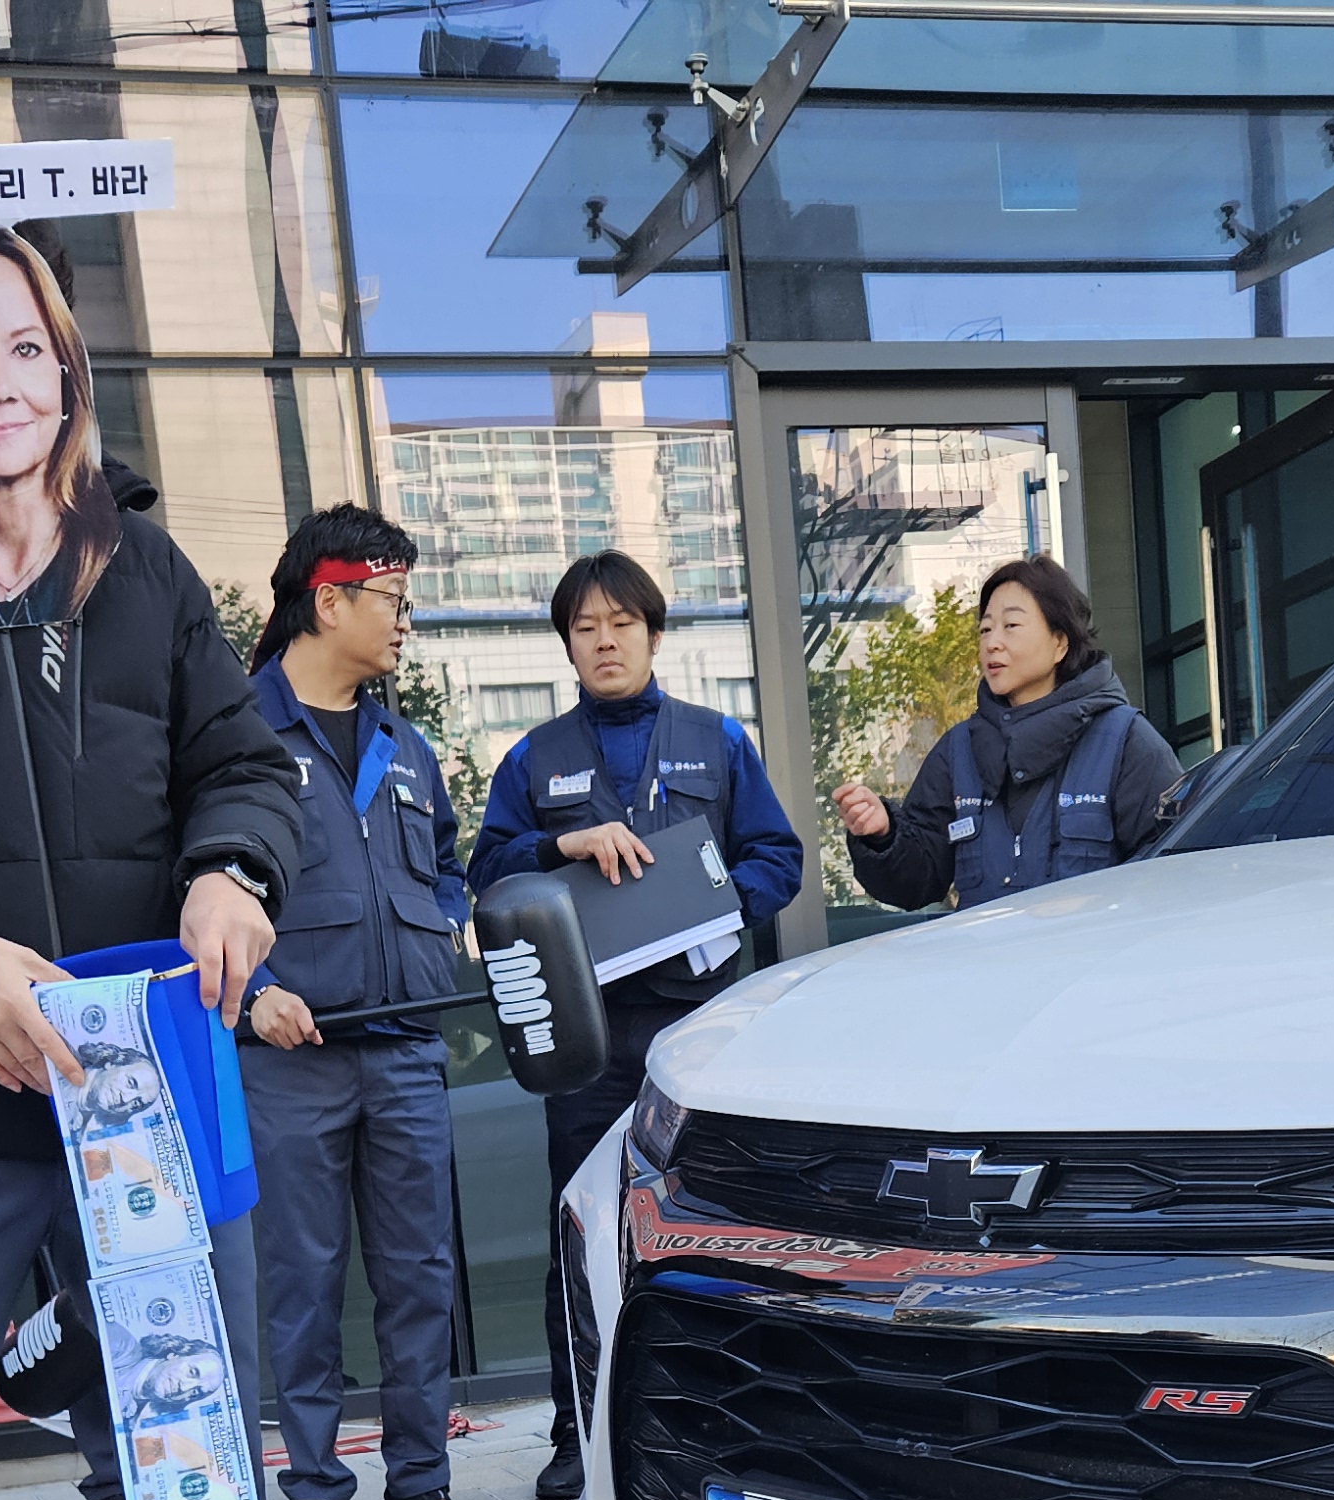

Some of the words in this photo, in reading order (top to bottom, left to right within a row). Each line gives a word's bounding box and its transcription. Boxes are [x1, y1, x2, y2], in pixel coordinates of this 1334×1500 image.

[42, 168, 75, 198] T.
[92, 164, 148, 196] 바라
[483, 939, 552, 1025] 1000
[523, 1021, 555, 1056] ton
[1141, 1385, 1255, 1415] RS
